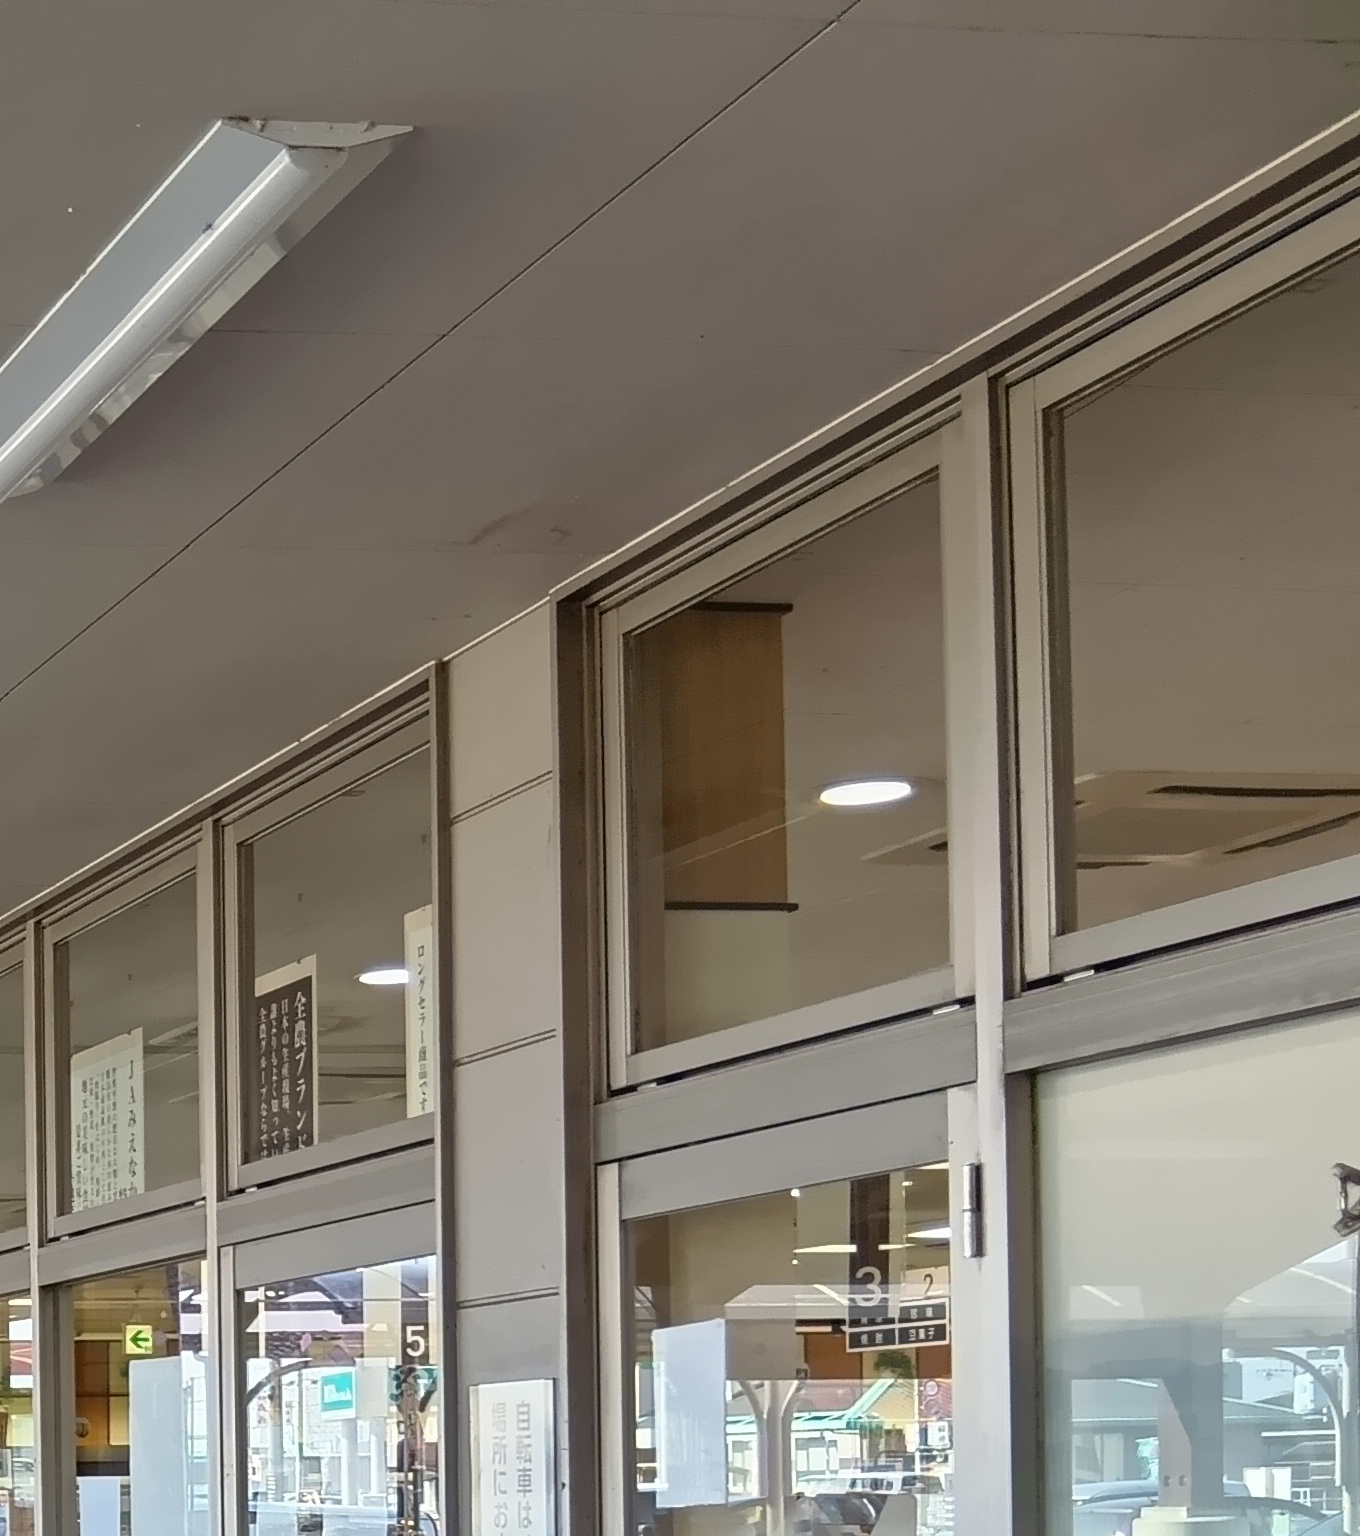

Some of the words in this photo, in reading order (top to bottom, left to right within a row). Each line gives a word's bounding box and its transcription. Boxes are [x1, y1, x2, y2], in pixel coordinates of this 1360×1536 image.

[294, 991, 308, 1150] 全農ブランド
[855, 1266, 882, 1307] 3
[405, 1325, 426, 1357] 5
